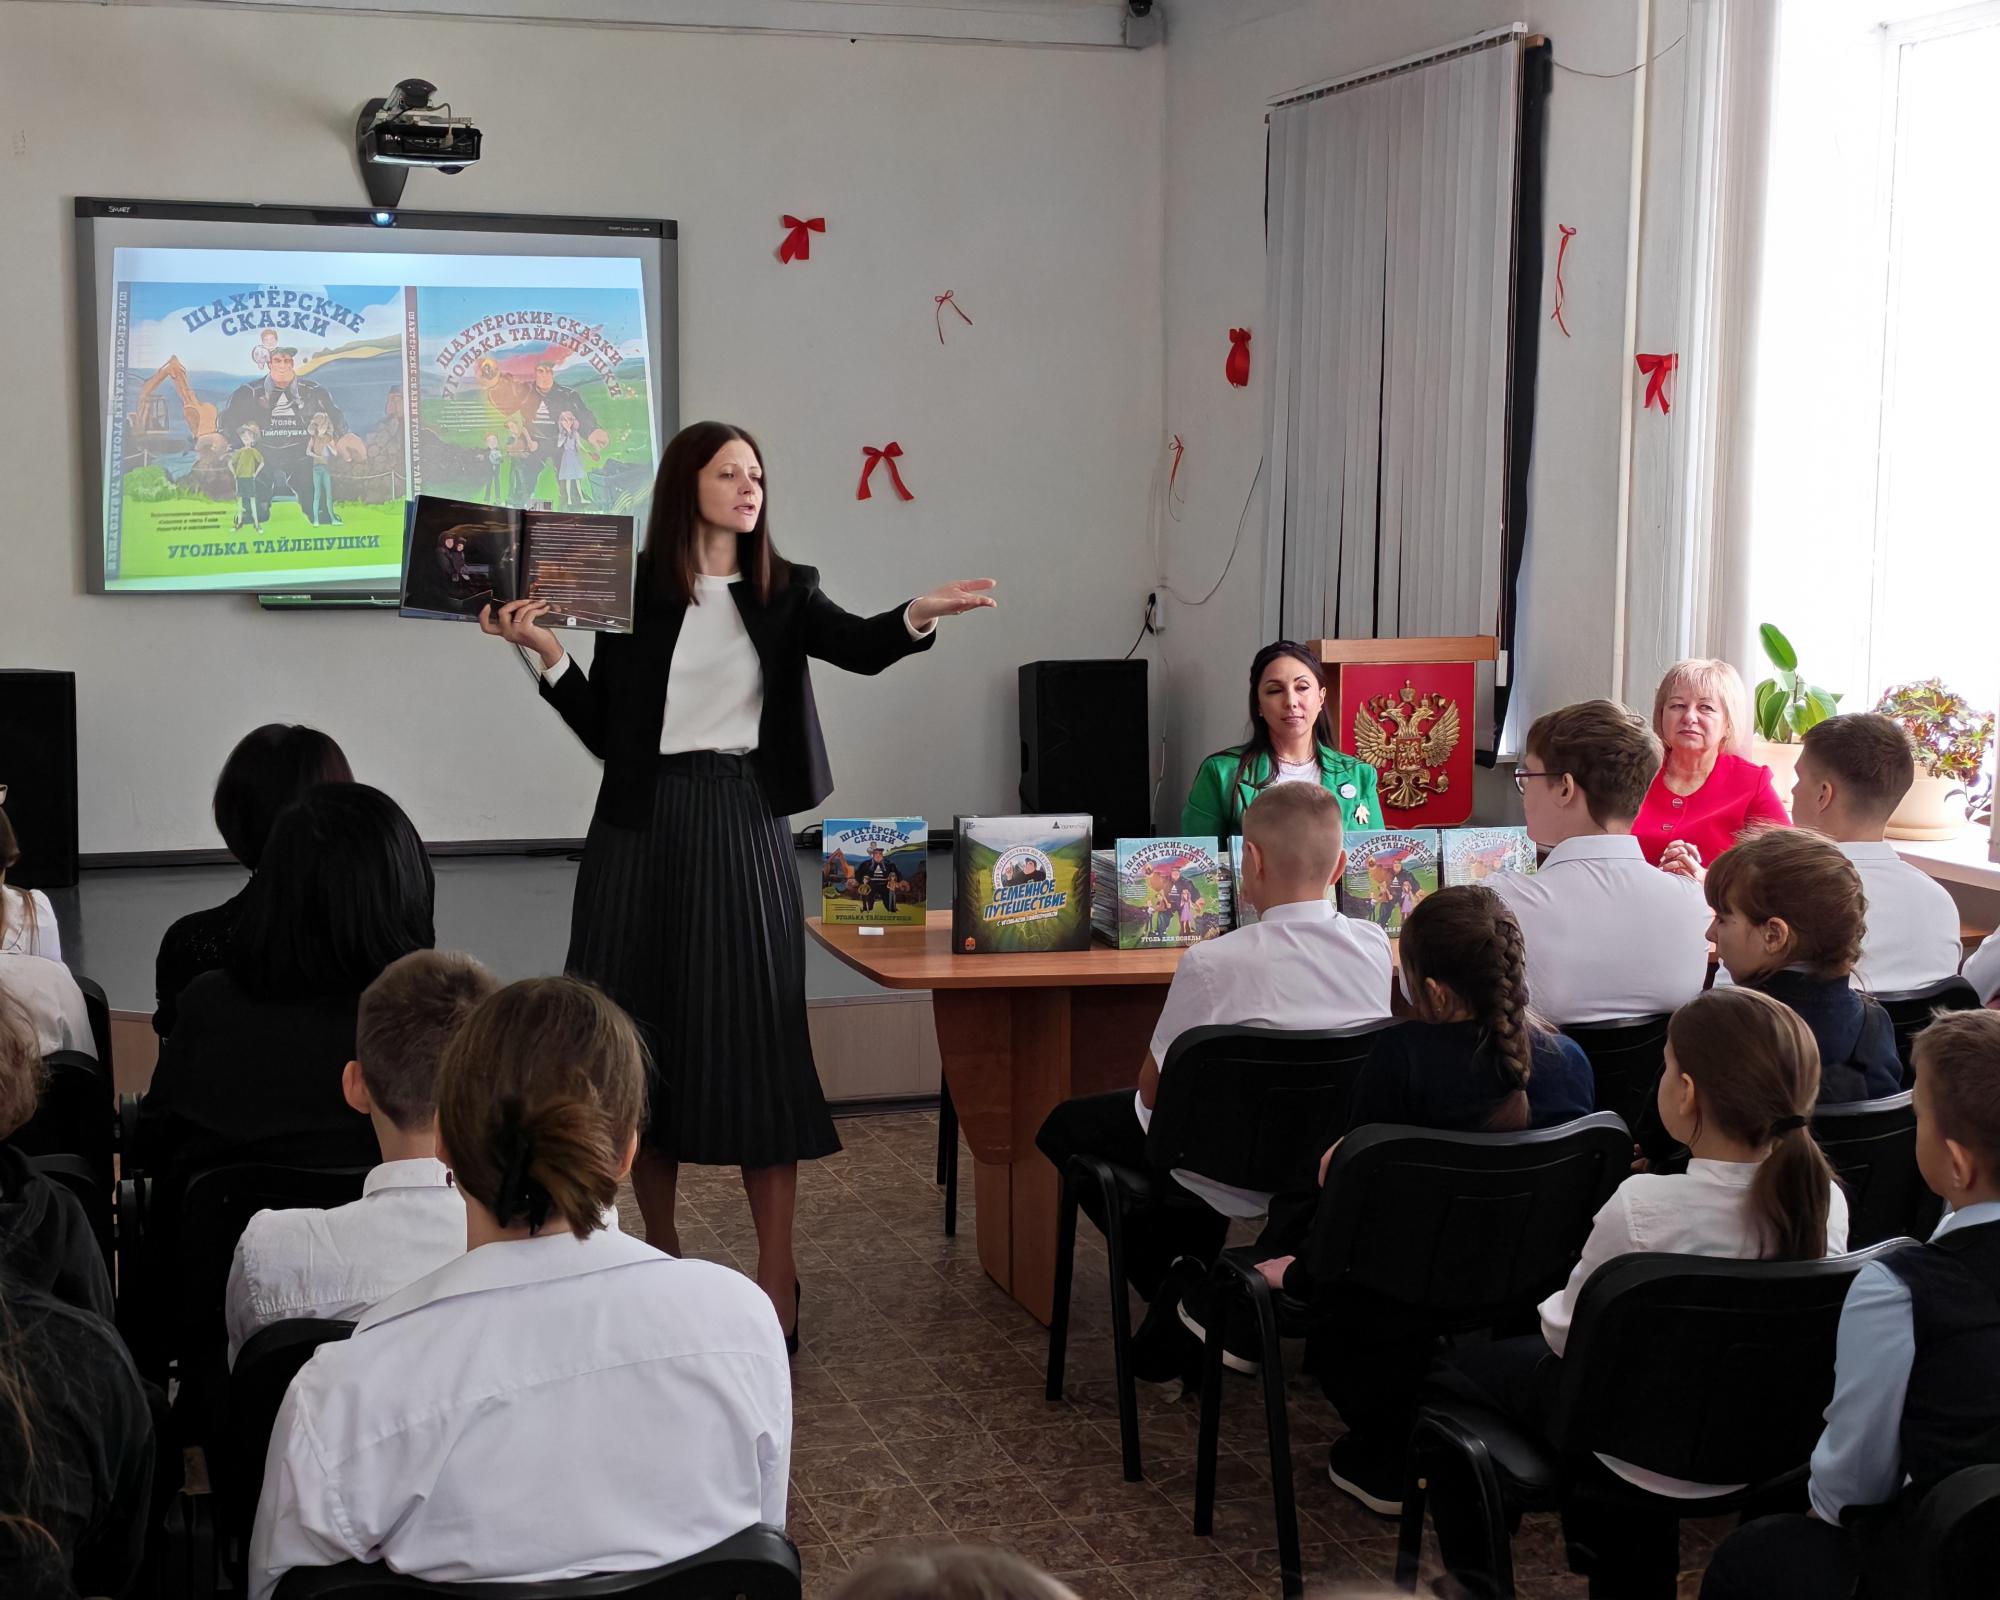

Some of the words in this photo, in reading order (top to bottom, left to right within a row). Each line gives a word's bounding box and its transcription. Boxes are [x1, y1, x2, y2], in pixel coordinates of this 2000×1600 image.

[182, 285, 366, 333] ШАХТЁРСКИЕ
[221, 310, 331, 337] СКАЗКИ
[436, 311, 553, 370] ШАХТЁРСКИЕ
[556, 316, 624, 366] СКАЗКИ
[442, 334, 507, 400] УГОЛЬКА
[508, 325, 622, 398] ТАЙЛЕПУШКИ
[168, 541, 249, 559] УГОЛЬКА
[253, 535, 380, 555] ТАЙЛЕПУШКИ
[839, 824, 910, 843] ШАХТЁРСКИЕ
[854, 833, 896, 845] СКАЗКИ
[1124, 841, 1182, 869] ШАХТЁРСКИЕ
[1183, 843, 1215, 868] СКАЗКИ
[1404, 836, 1434, 860] СКАЗКИ
[1126, 852, 1158, 886] УГОЛЬКА
[993, 879, 1056, 902] СЕМЕЙНОЕ
[984, 893, 1067, 919] ПУТЕШЕСТВИЕ
